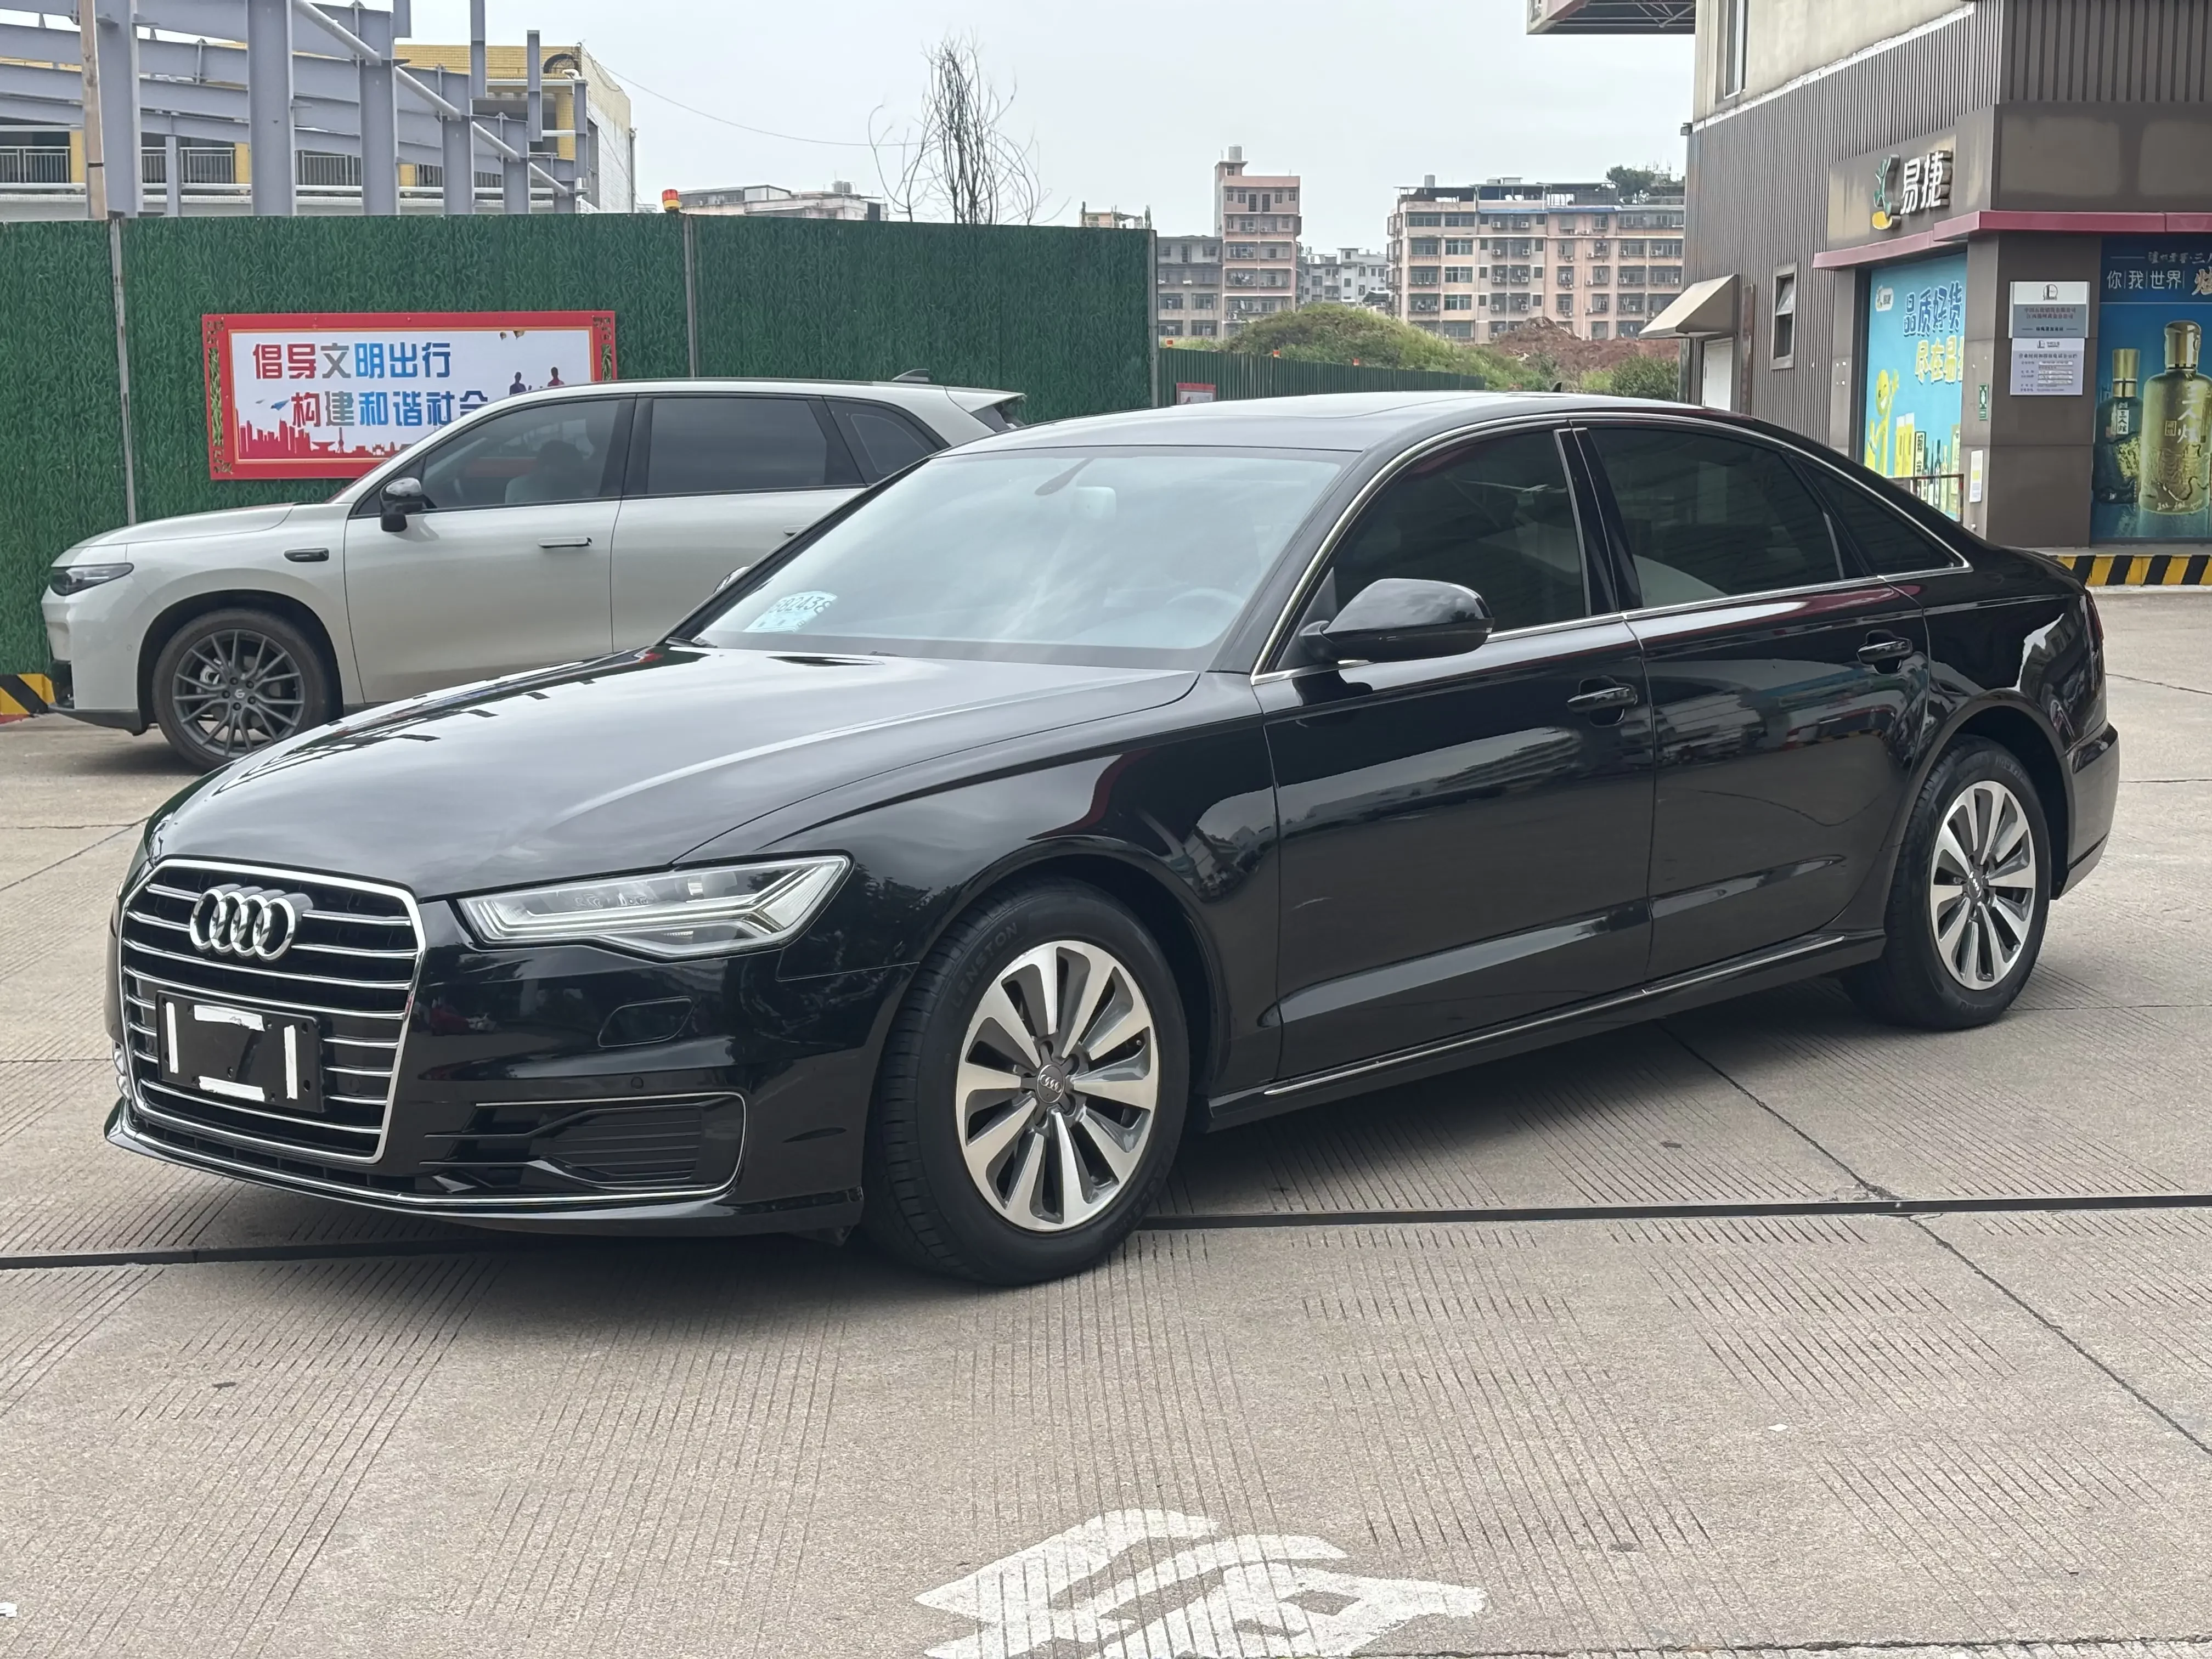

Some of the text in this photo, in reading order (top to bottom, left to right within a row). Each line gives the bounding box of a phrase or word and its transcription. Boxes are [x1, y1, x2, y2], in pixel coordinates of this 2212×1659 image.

[1900, 151, 1944, 215] 易捷
[1904, 281, 1962, 336] 品质好货
[253, 342, 450, 379] 倡导文明出行
[1915, 335, 1964, 384] 尽在易
[291, 391, 488, 428] 构建和谐社会
